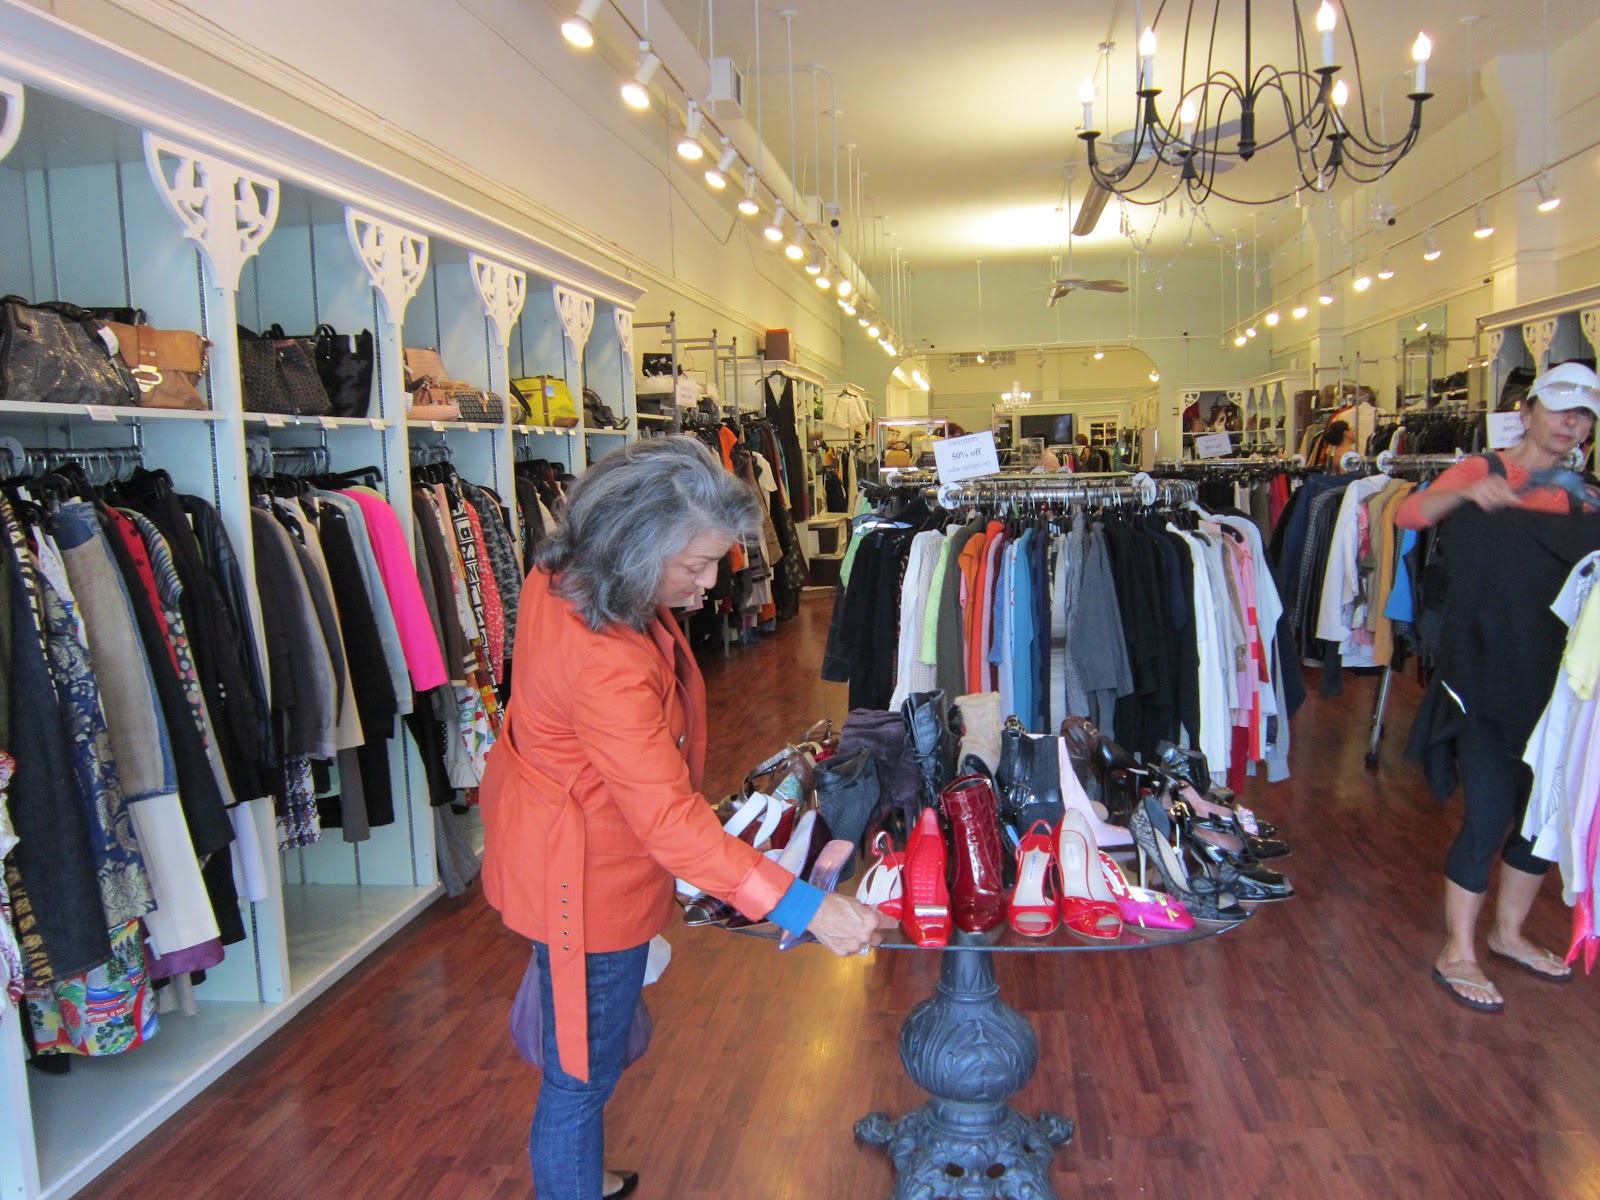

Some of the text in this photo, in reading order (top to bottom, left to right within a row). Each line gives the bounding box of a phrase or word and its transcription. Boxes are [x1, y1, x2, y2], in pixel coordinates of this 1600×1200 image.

[948, 436, 979, 447] sweaters
[951, 447, 982, 461] 50% off
